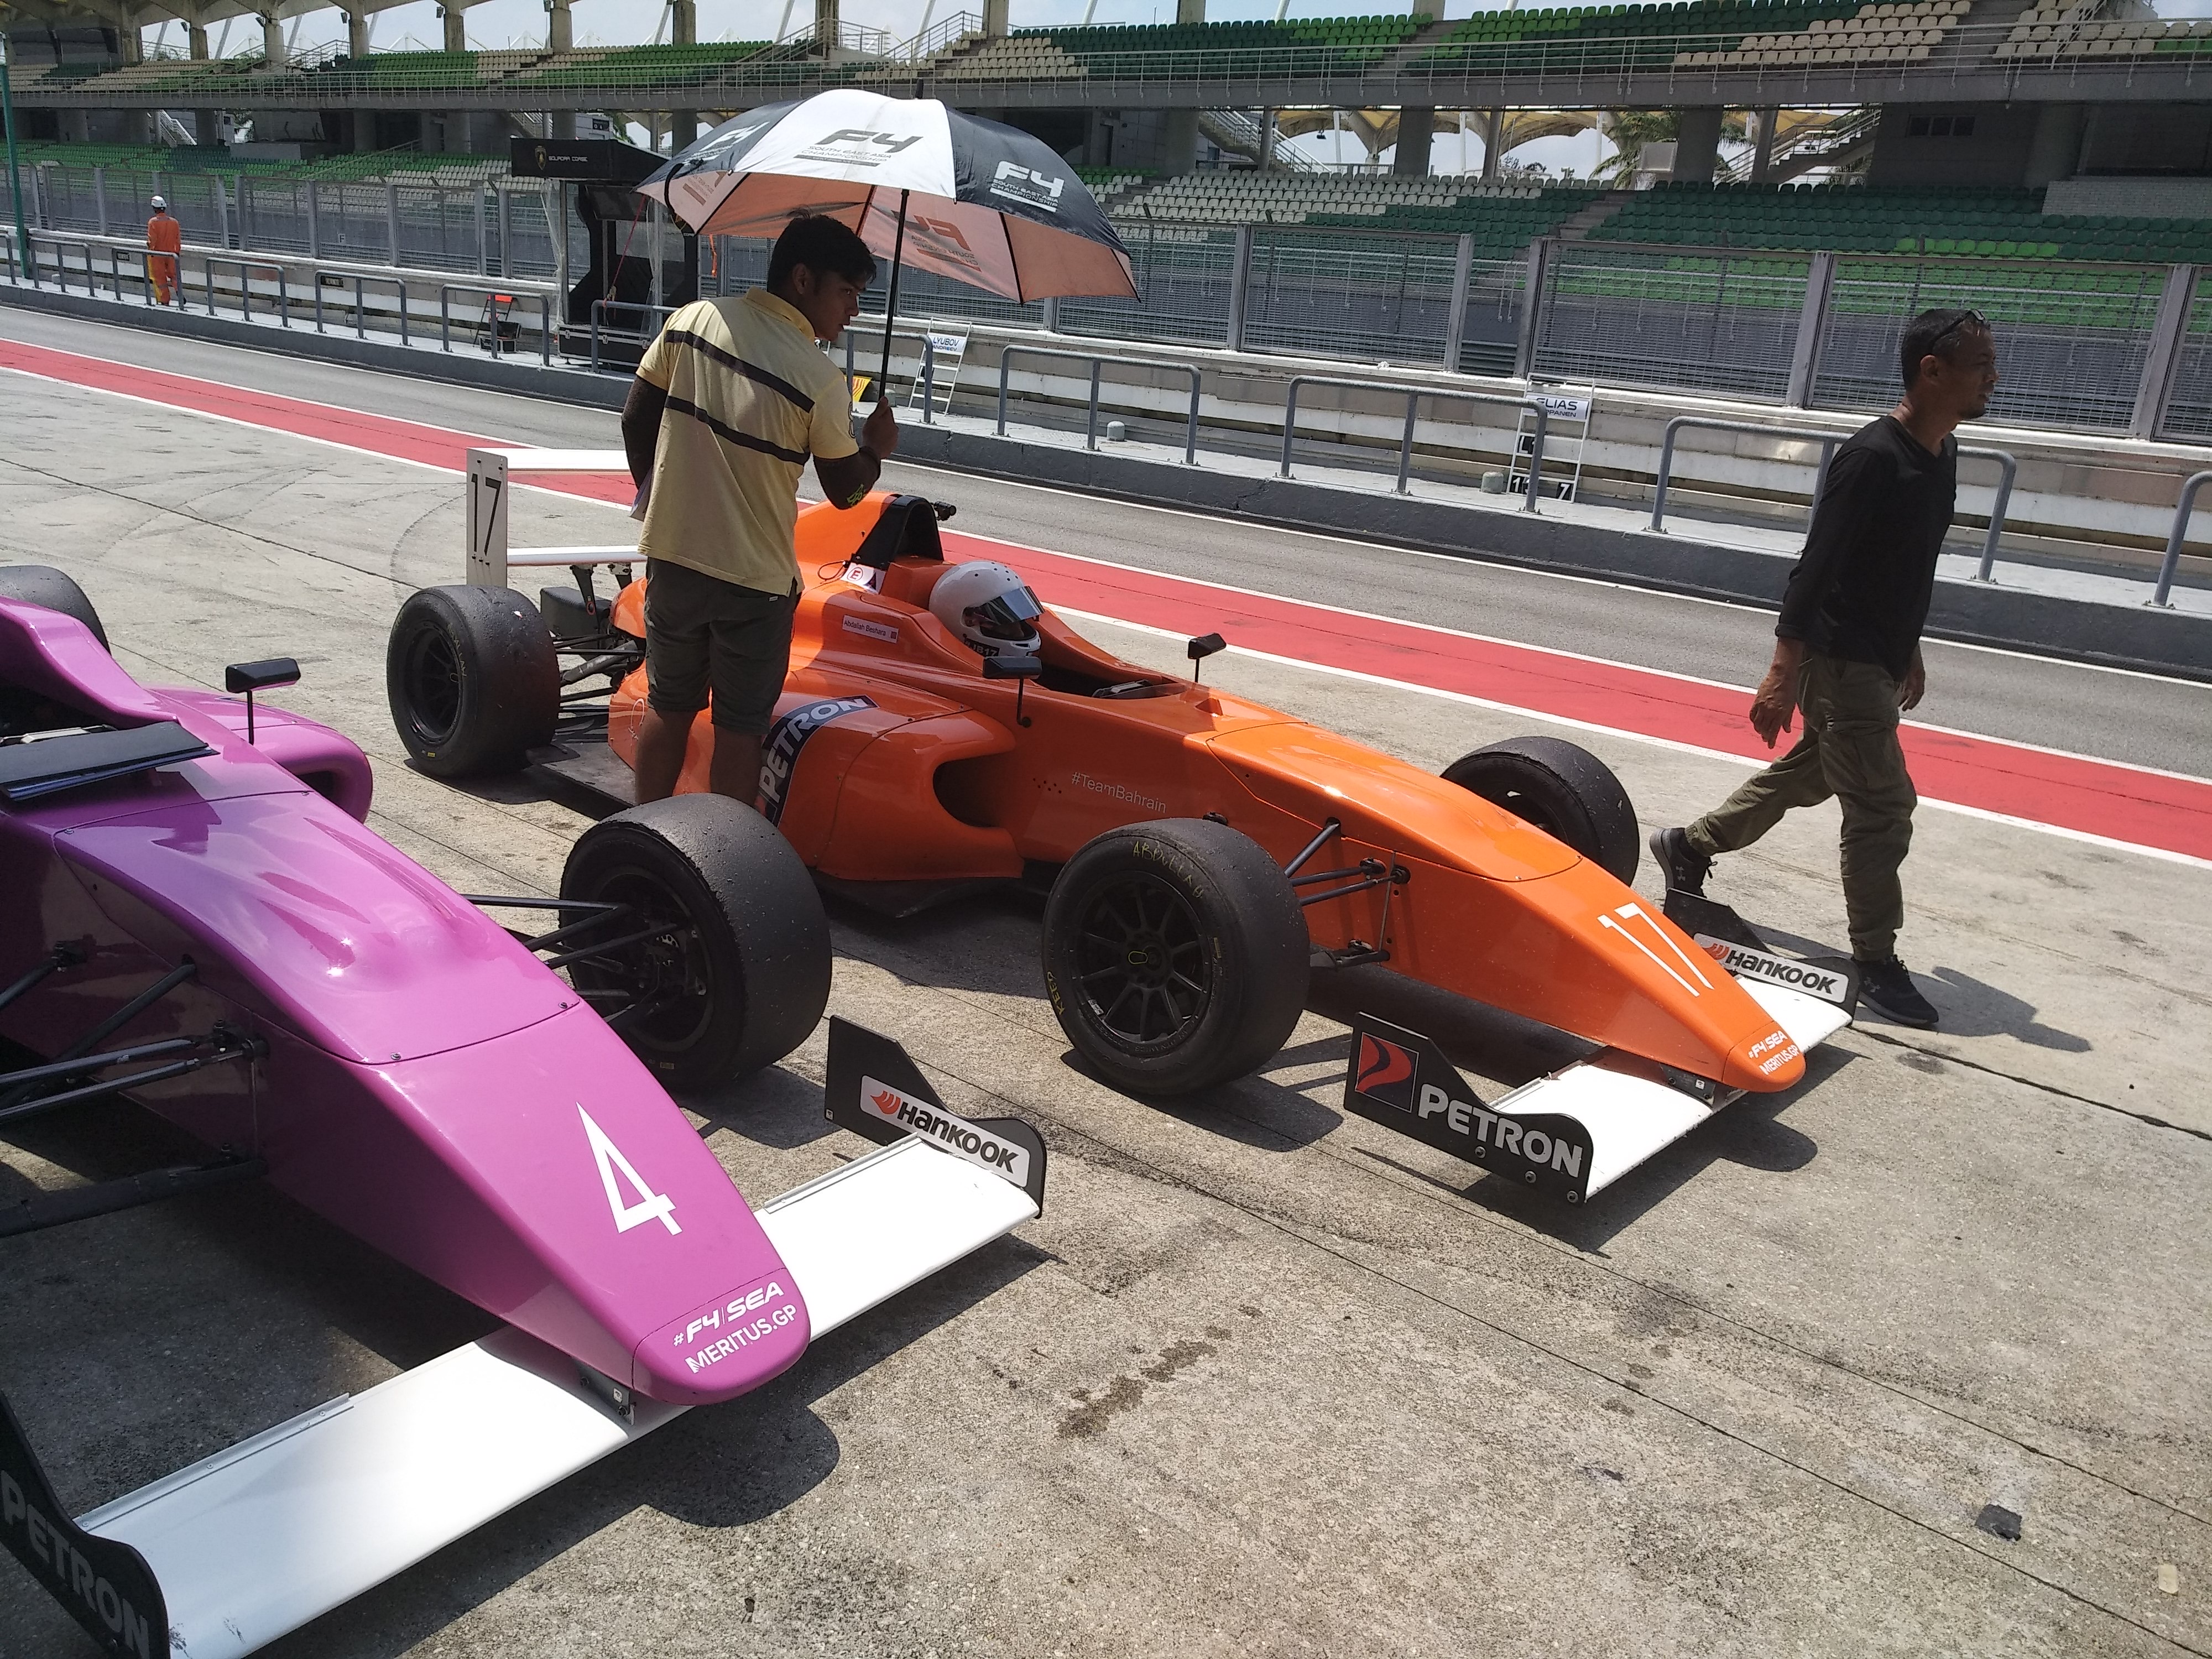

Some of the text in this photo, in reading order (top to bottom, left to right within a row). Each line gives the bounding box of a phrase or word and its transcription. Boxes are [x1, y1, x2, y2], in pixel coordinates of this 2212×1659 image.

[801, 149, 887, 163] CHAMPIONSHIP
[815, 129, 924, 153] F4
[991, 183, 1058, 207] CHAMPIONSHIP
[993, 179, 1058, 204] SOUTH EAST ASIA
[994, 160, 1065, 197] F4
[933, 337, 959, 347] LYUBOV
[471, 473, 502, 556] 17
[844, 619, 886, 637] Abdallah Beshara
[758, 698, 869, 803] PETRON
[1071, 771, 1167, 813] #TeamBahrain
[1597, 901, 1714, 997] 17
[1047, 971, 1065, 1015] KEEP
[1759, 1044, 1799, 1075] MERITUS.GP
[1418, 1083, 1583, 1178] PETRON
[576, 1101, 683, 1236] 4
[685, 1304, 797, 1374] MERITUS.GP
[1, 1469, 150, 1659] PETRON
